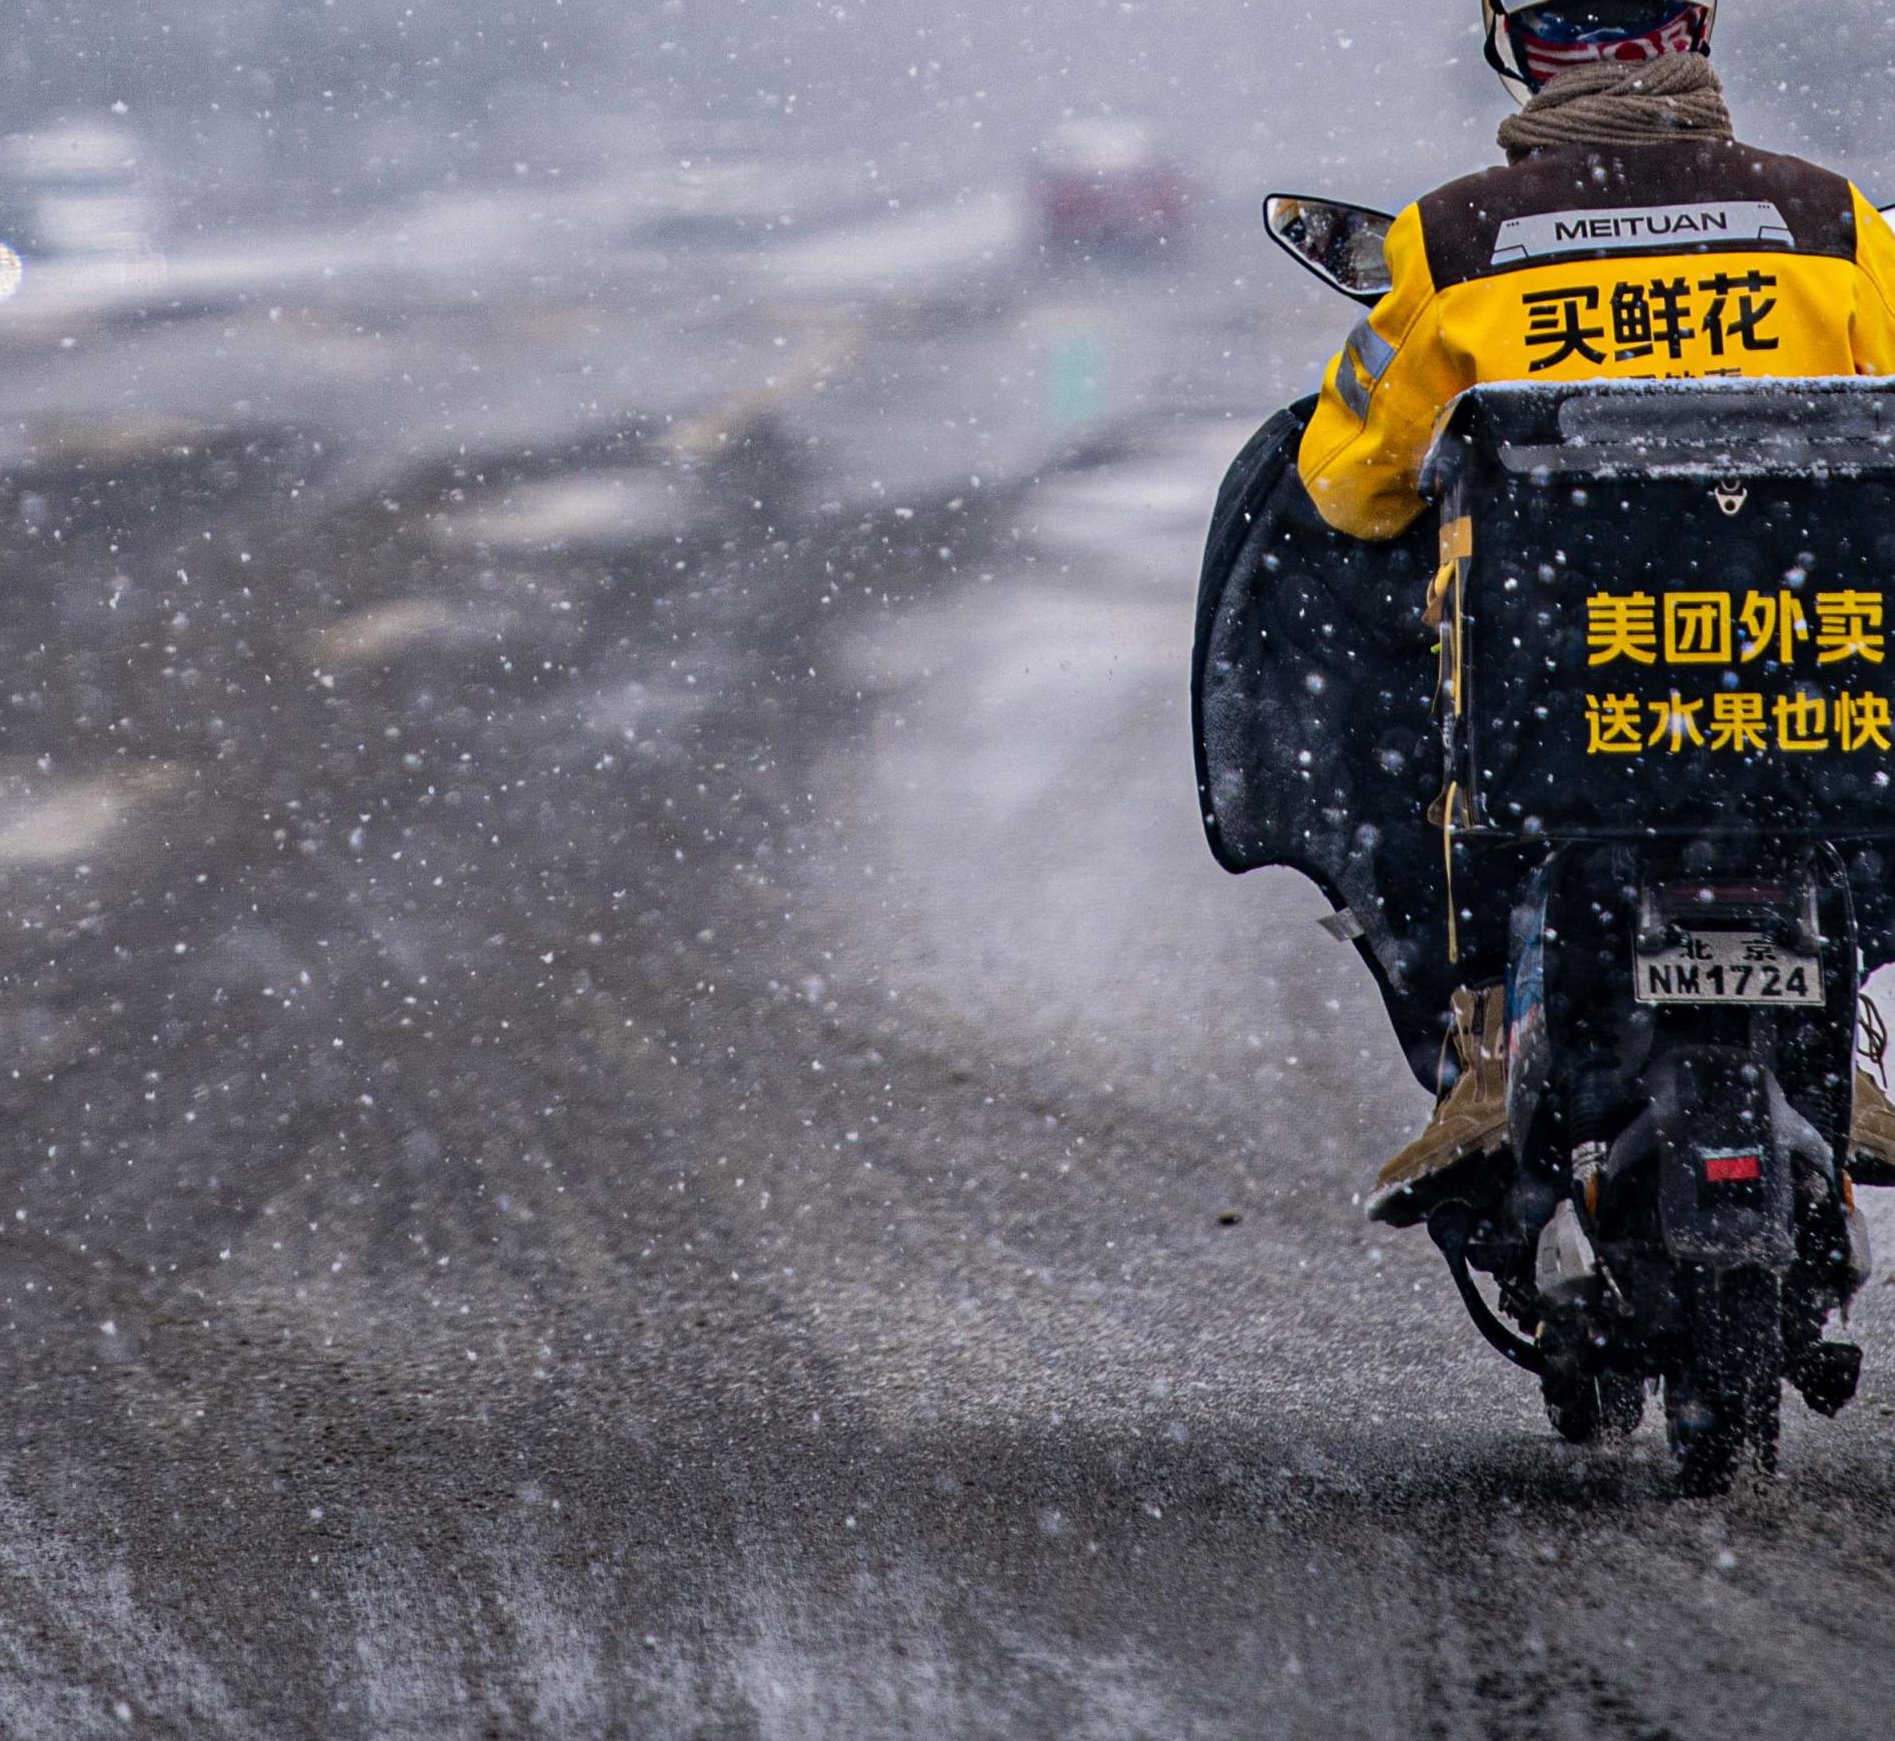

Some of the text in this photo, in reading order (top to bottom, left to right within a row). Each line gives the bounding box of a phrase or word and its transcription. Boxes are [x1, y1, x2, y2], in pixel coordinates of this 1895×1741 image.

[1554, 211, 1728, 242] MEITUAN
[1521, 269, 1780, 373] 买鲜花
[1586, 589, 1886, 666] 美团外卖
[1584, 690, 1892, 754] 送水果也快
[1648, 964, 1809, 997] NM1724
